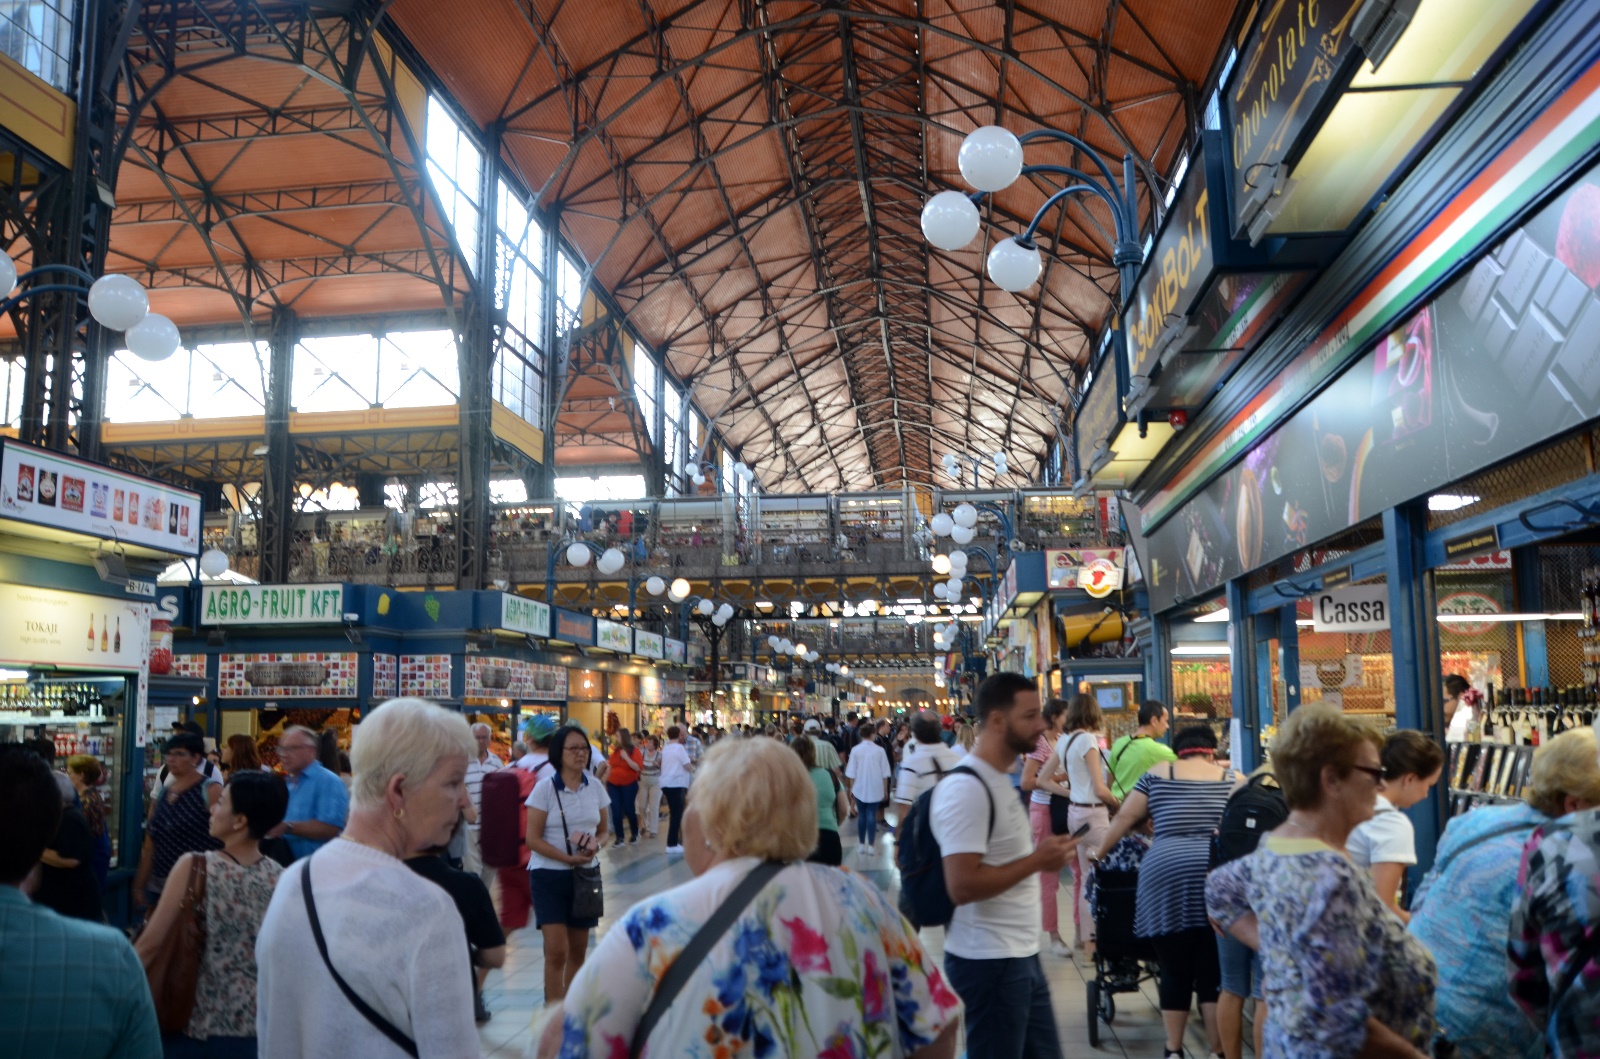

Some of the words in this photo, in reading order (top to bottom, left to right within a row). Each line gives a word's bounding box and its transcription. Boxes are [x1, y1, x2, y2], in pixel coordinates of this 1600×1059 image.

[206, 588, 306, 620] AGRO-FRUIT
[1319, 594, 1385, 624] Cassa
[25, 620, 58, 635] TOKAJI
